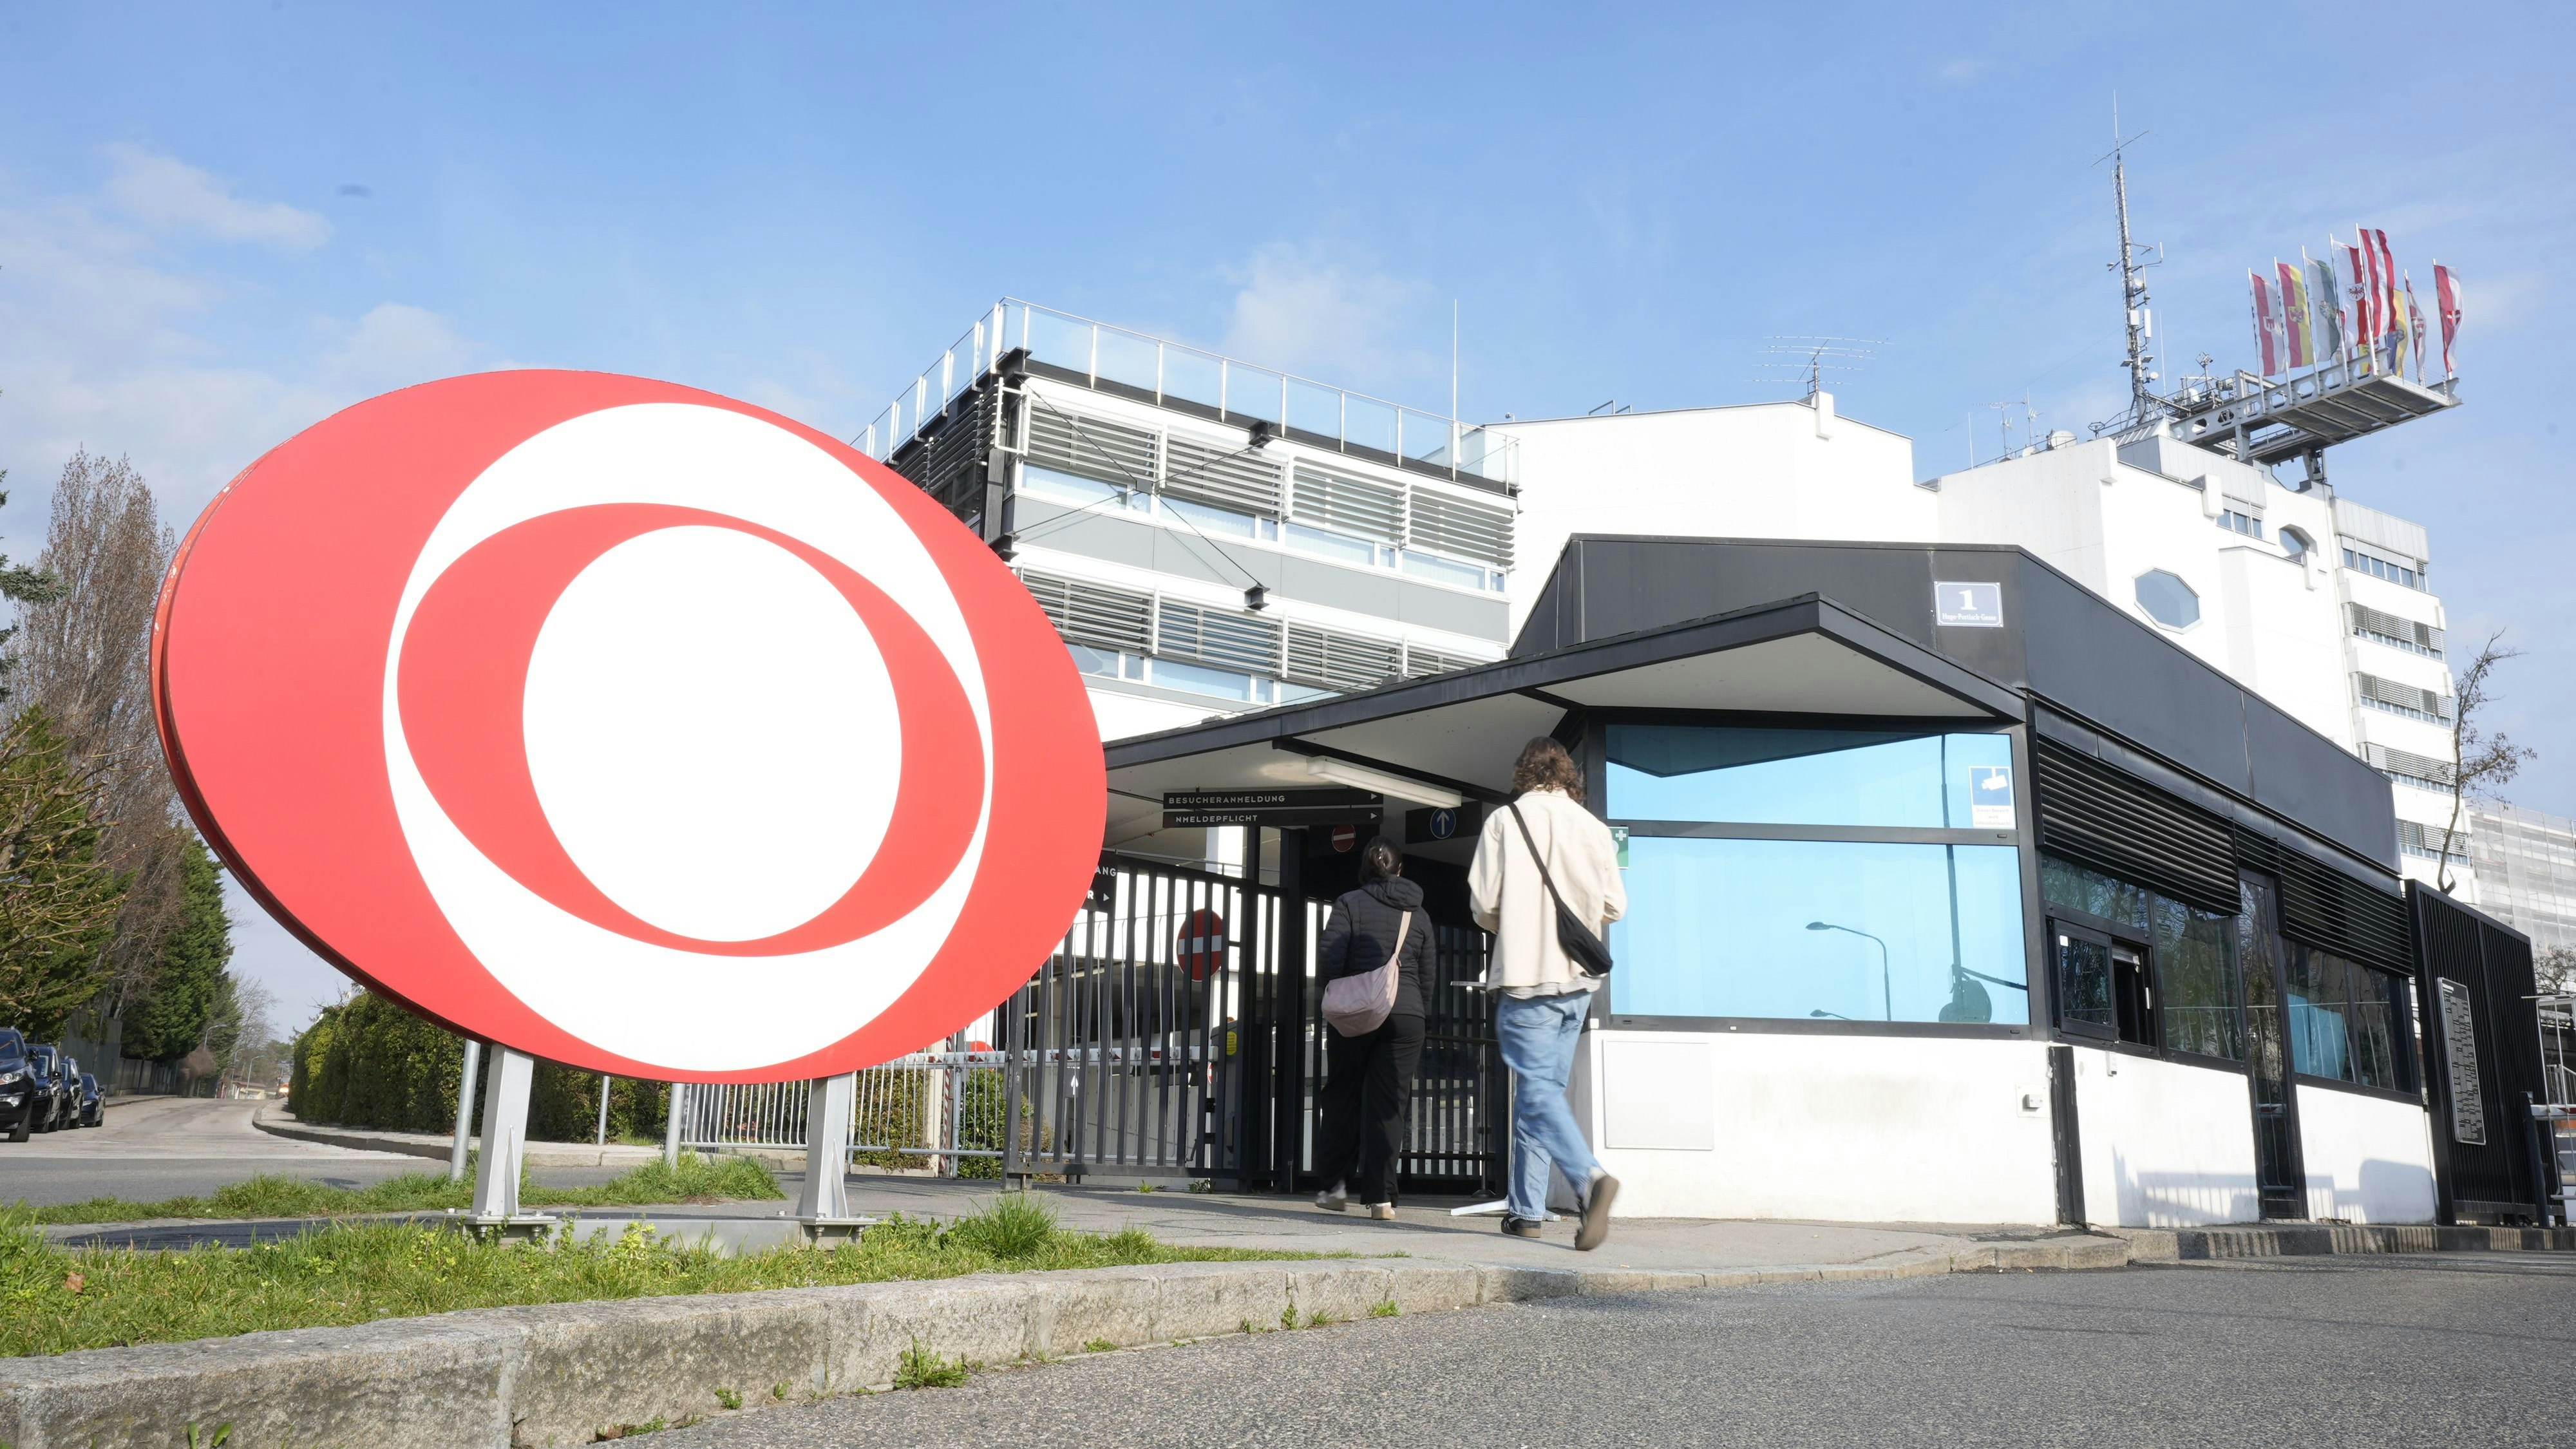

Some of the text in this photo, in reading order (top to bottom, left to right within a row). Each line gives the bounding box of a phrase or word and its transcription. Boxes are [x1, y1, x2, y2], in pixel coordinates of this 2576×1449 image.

[1958, 589, 1978, 611] 1
[1168, 795, 1285, 804] BESUCHERANMELDUNG
[1175, 815, 1258, 823] NMELDEPFLICHT
